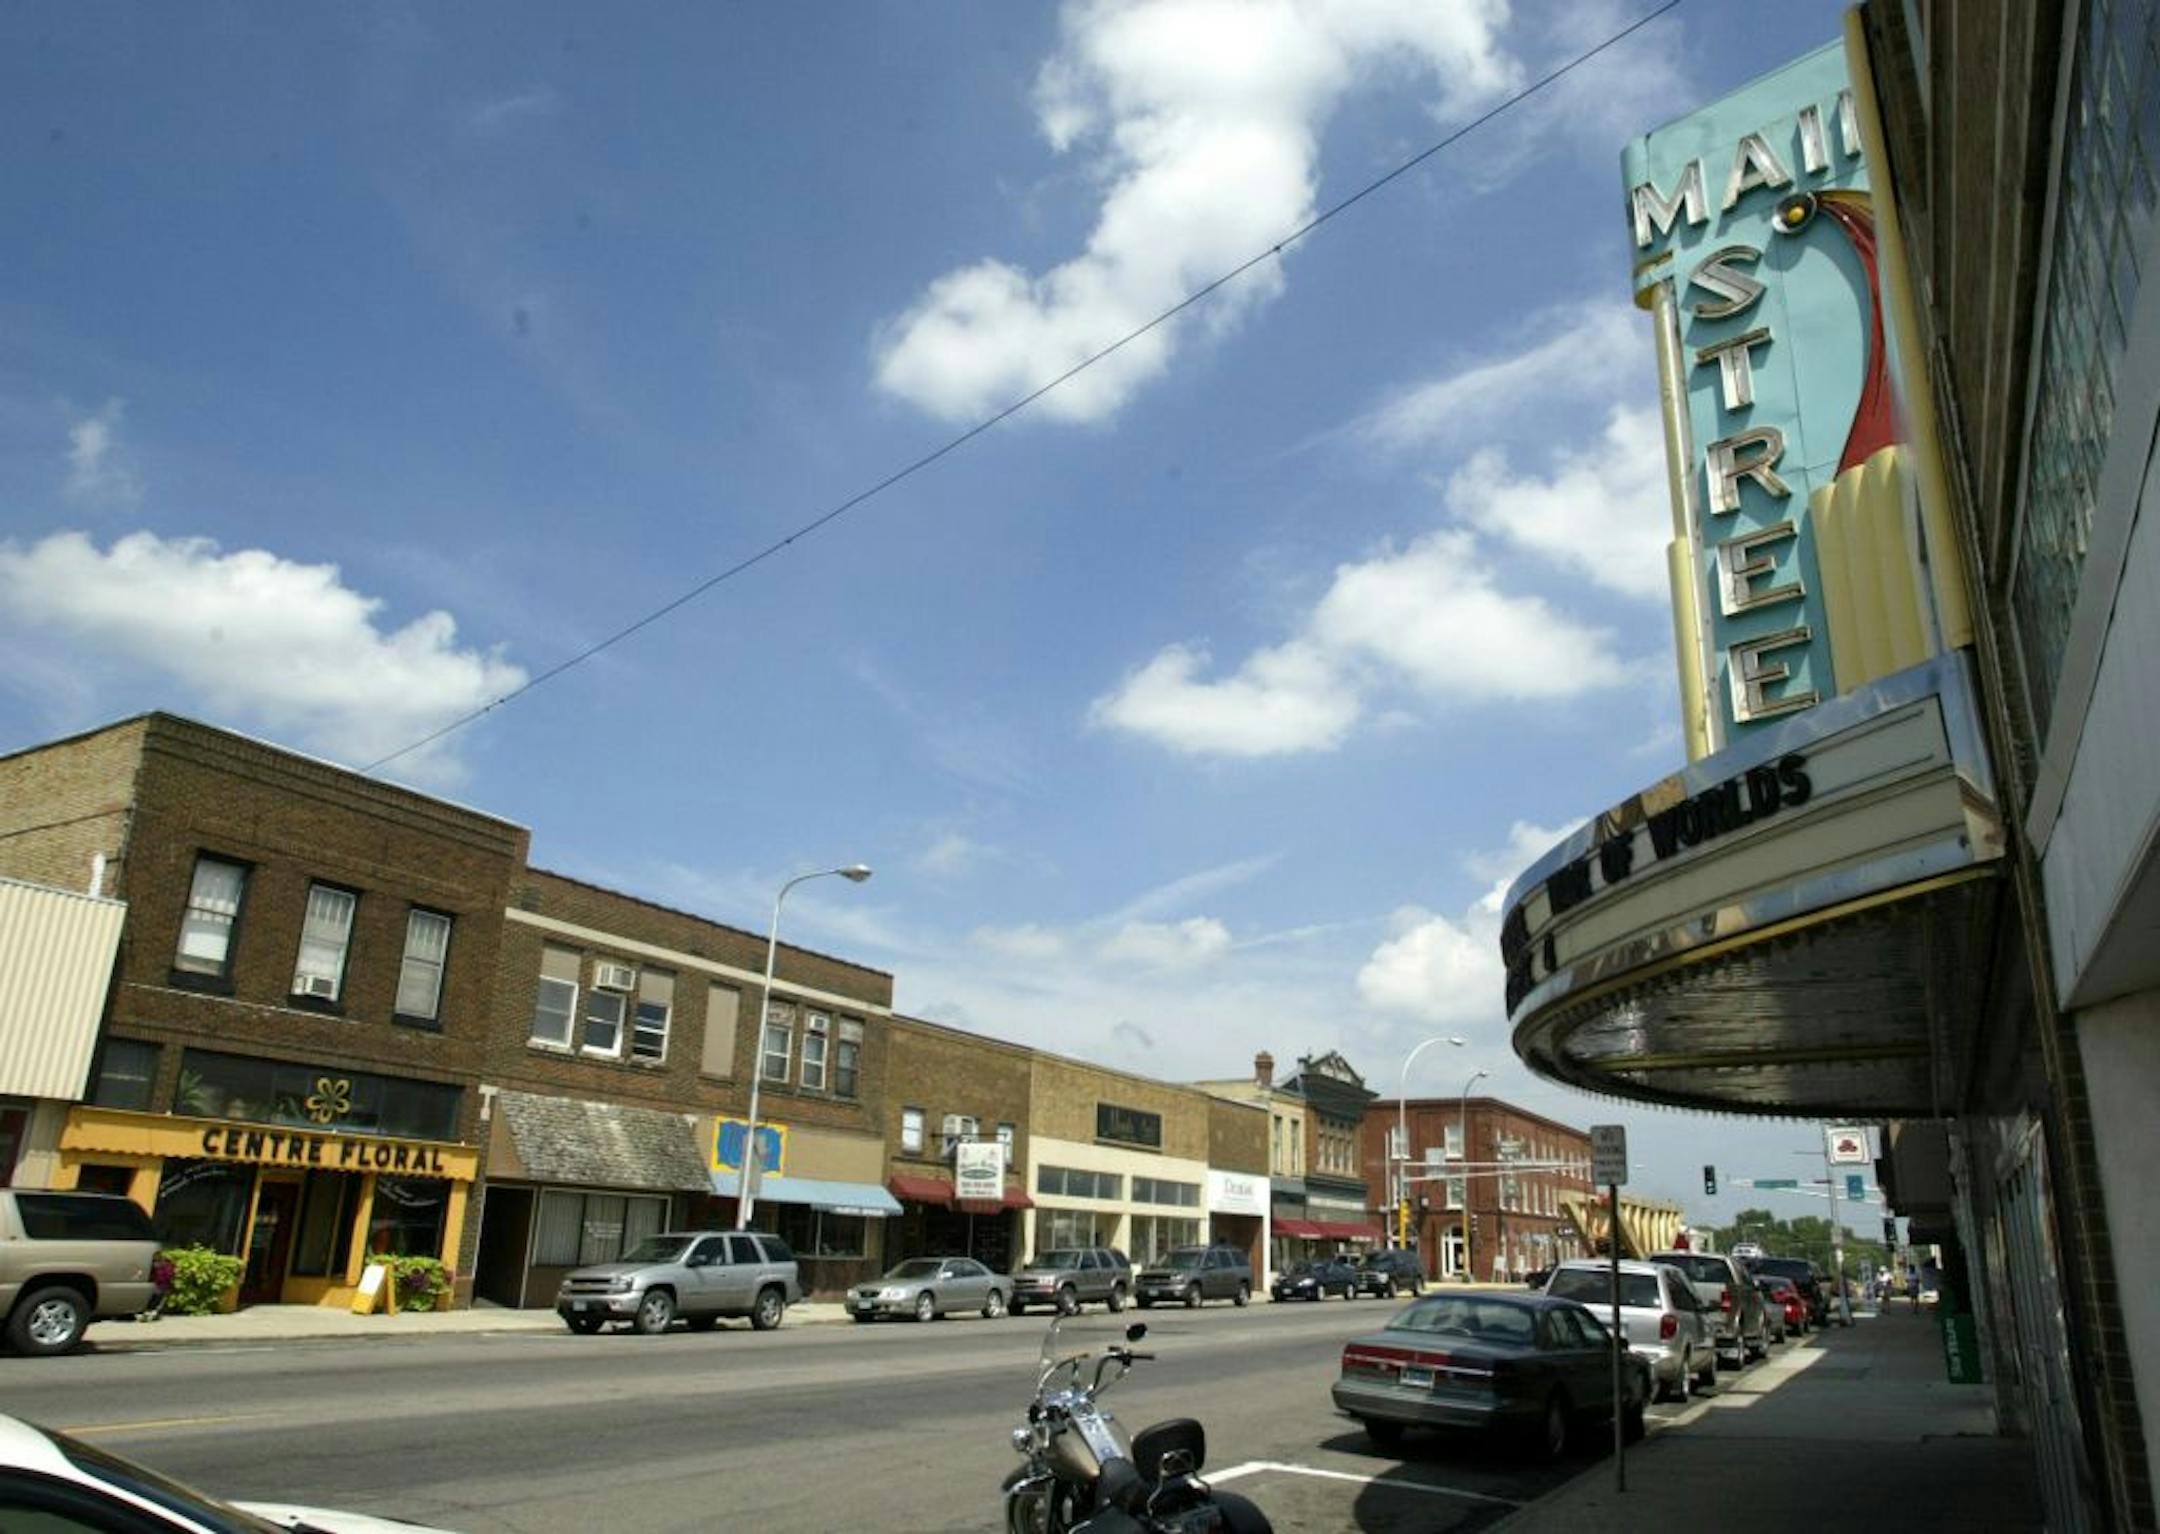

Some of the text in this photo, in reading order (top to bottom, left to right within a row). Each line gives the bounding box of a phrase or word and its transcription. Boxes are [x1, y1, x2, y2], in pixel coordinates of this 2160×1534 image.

[1647, 753, 1813, 860] WORLDS
[203, 1127, 444, 1171] CENTRE FLORAL
